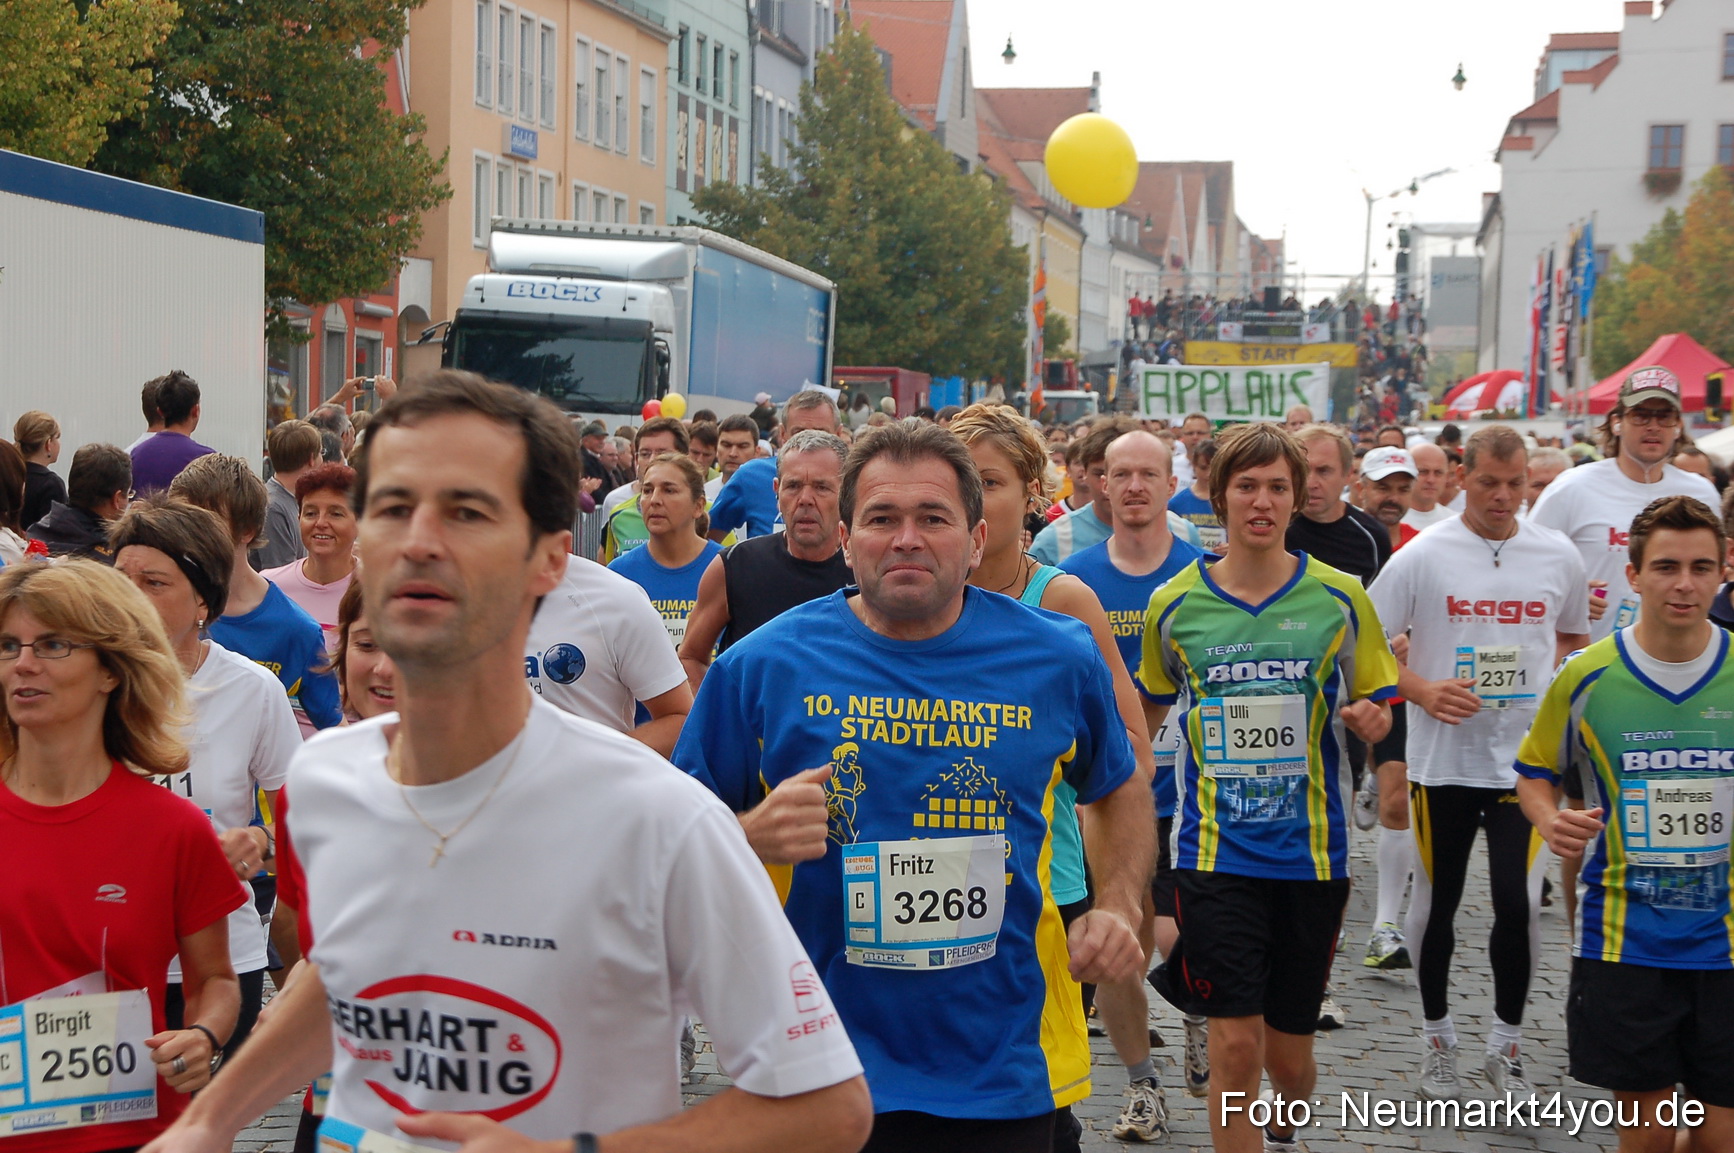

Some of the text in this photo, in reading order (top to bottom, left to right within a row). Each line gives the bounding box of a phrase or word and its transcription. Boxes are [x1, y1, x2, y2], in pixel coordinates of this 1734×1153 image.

[508, 281, 602, 303] BOCK
[1446, 595, 1546, 625] kago
[1204, 643, 1253, 658] TEAM
[1480, 650, 1517, 663] Michael
[1206, 660, 1311, 684] BOCK
[1481, 669, 1527, 688] 2371
[803, 695, 1032, 730] 10. NEUMARKTER
[1230, 704, 1250, 719] Ulli
[841, 717, 998, 748] STADTLAUF
[1209, 726, 1295, 749] C 3206
[1621, 730, 1675, 743] TEAM
[1267, 762, 1307, 771] PFLEIDERER
[1621, 749, 1734, 773] BOCK
[1655, 787, 1713, 804] Andreas
[1657, 812, 1724, 837] 3188
[890, 853, 934, 877] Fritz
[855, 886, 988, 925] C 3268
[482, 933, 558, 951] ADRIA
[35, 1010, 92, 1037] Birgit
[40, 1041, 137, 1084] 2560
[393, 1048, 533, 1096] JÄNIG
[98, 1097, 155, 1114] PFLEIDERER
